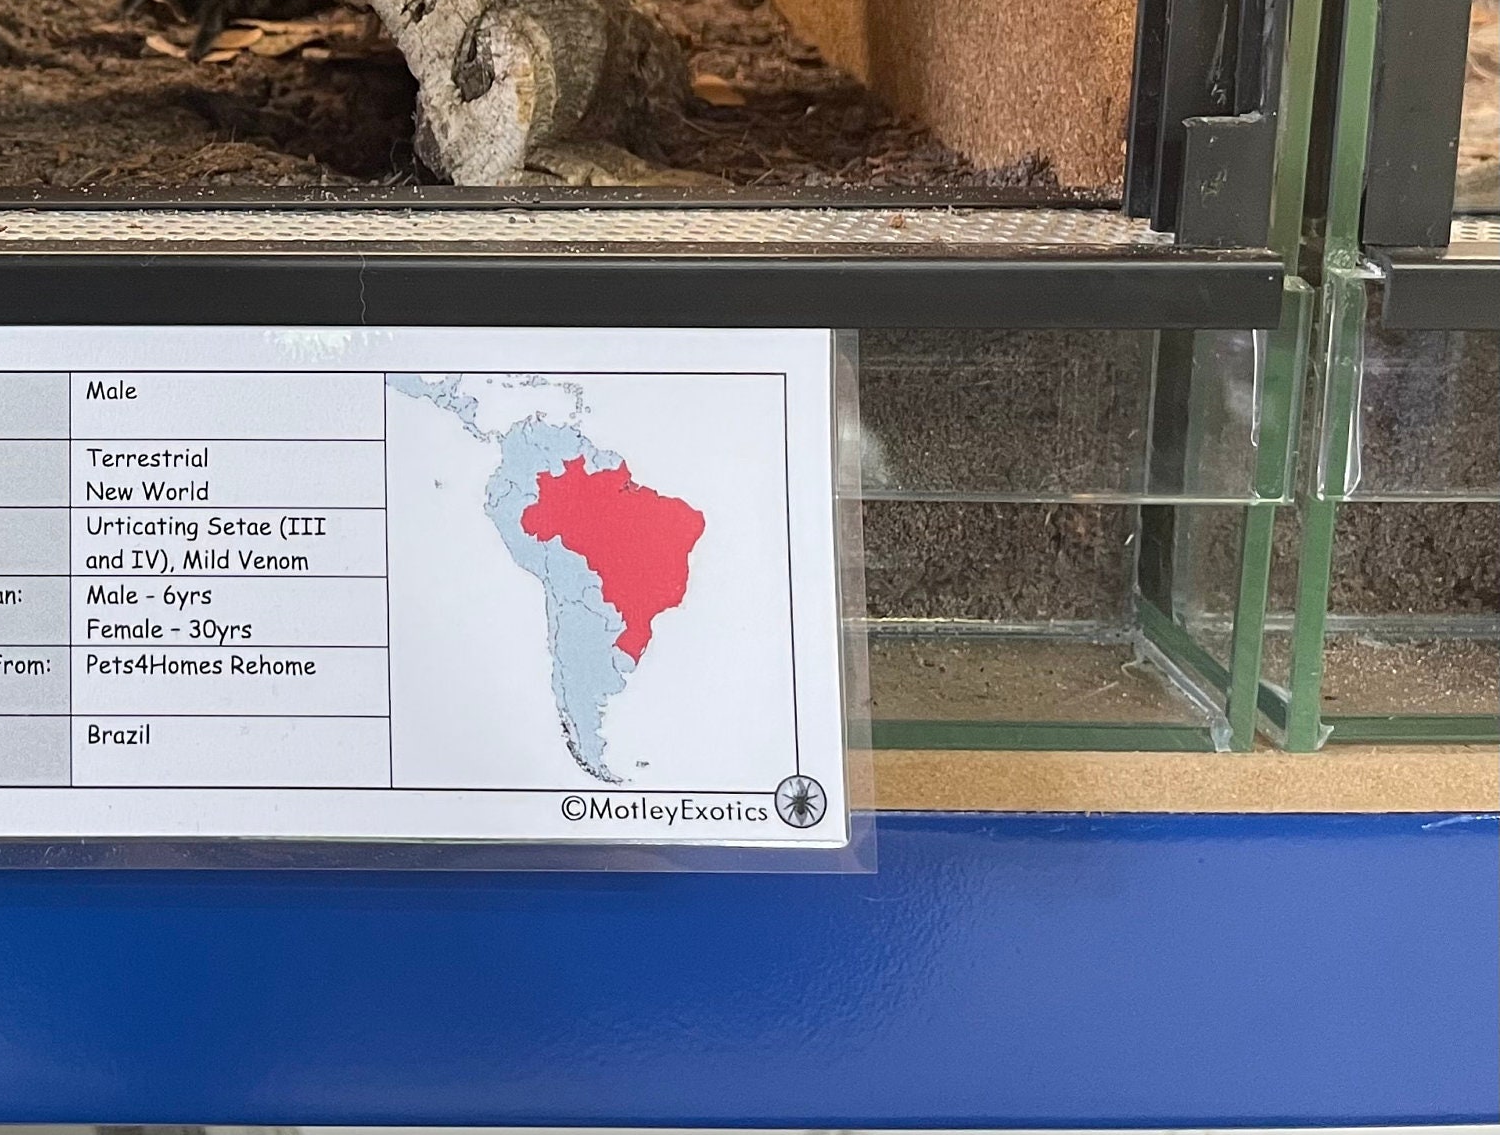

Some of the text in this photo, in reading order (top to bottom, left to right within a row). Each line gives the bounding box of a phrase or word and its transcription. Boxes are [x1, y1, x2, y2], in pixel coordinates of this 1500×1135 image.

[86, 380, 137, 400] Male
[86, 447, 207, 467] Terrestrial
[87, 480, 208, 501] New World
[87, 516, 326, 541] Urticating Setae (III
[86, 549, 308, 574] and IV), Mild Venom
[87, 584, 138, 605] Male
[164, 585, 211, 611] 6yrs
[88, 618, 163, 640] Female
[189, 619, 252, 645] 30yrs
[87, 654, 316, 676] Pets4Homes Rehome
[88, 724, 149, 744] Brazil
